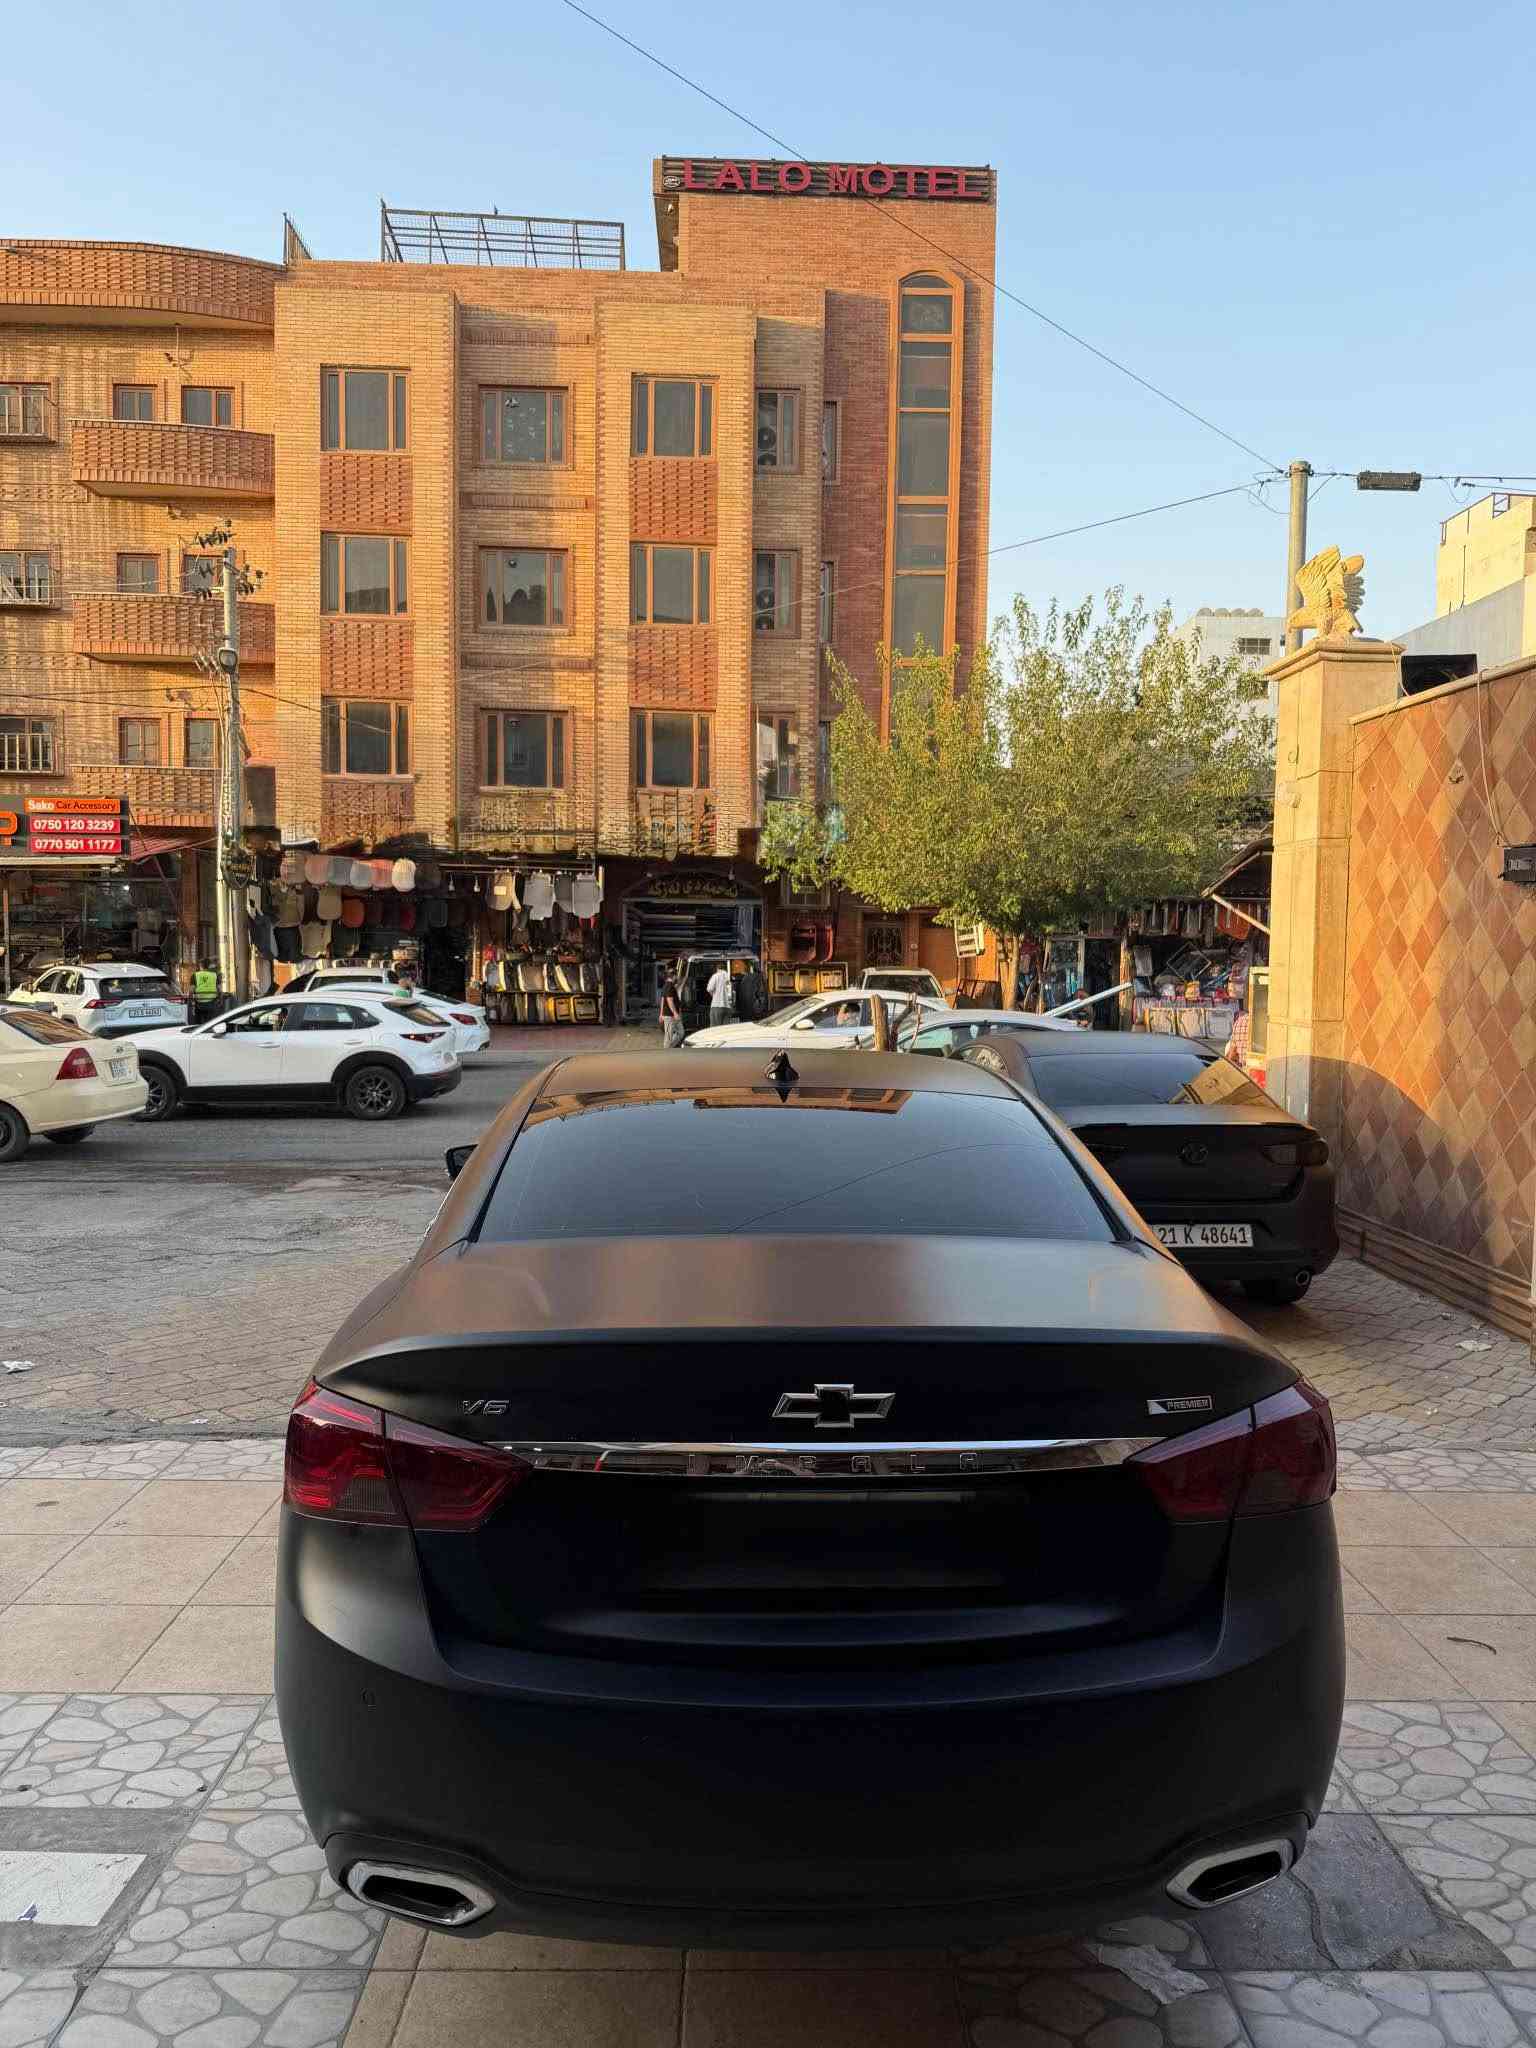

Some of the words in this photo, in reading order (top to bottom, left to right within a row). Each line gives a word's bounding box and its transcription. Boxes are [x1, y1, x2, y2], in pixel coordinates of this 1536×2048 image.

[683, 159, 812, 191] LALO
[828, 164, 982, 197] MOTEL
[28, 799, 55, 810] Sako
[56, 800, 70, 810] Car
[73, 800, 116, 812] Accessory
[33, 819, 61, 830] 0750
[64, 819, 84, 830] 120
[86, 819, 114, 830] 3239
[35, 839, 62, 850] 0770
[65, 839, 84, 850] 501
[87, 839, 115, 850] 1177
[1158, 1226, 1178, 1244] 21
[1183, 1225, 1194, 1245] K
[1200, 1226, 1249, 1244] 48641
[462, 1399, 510, 1416] V6
[1166, 1399, 1209, 1411] PREMIER
